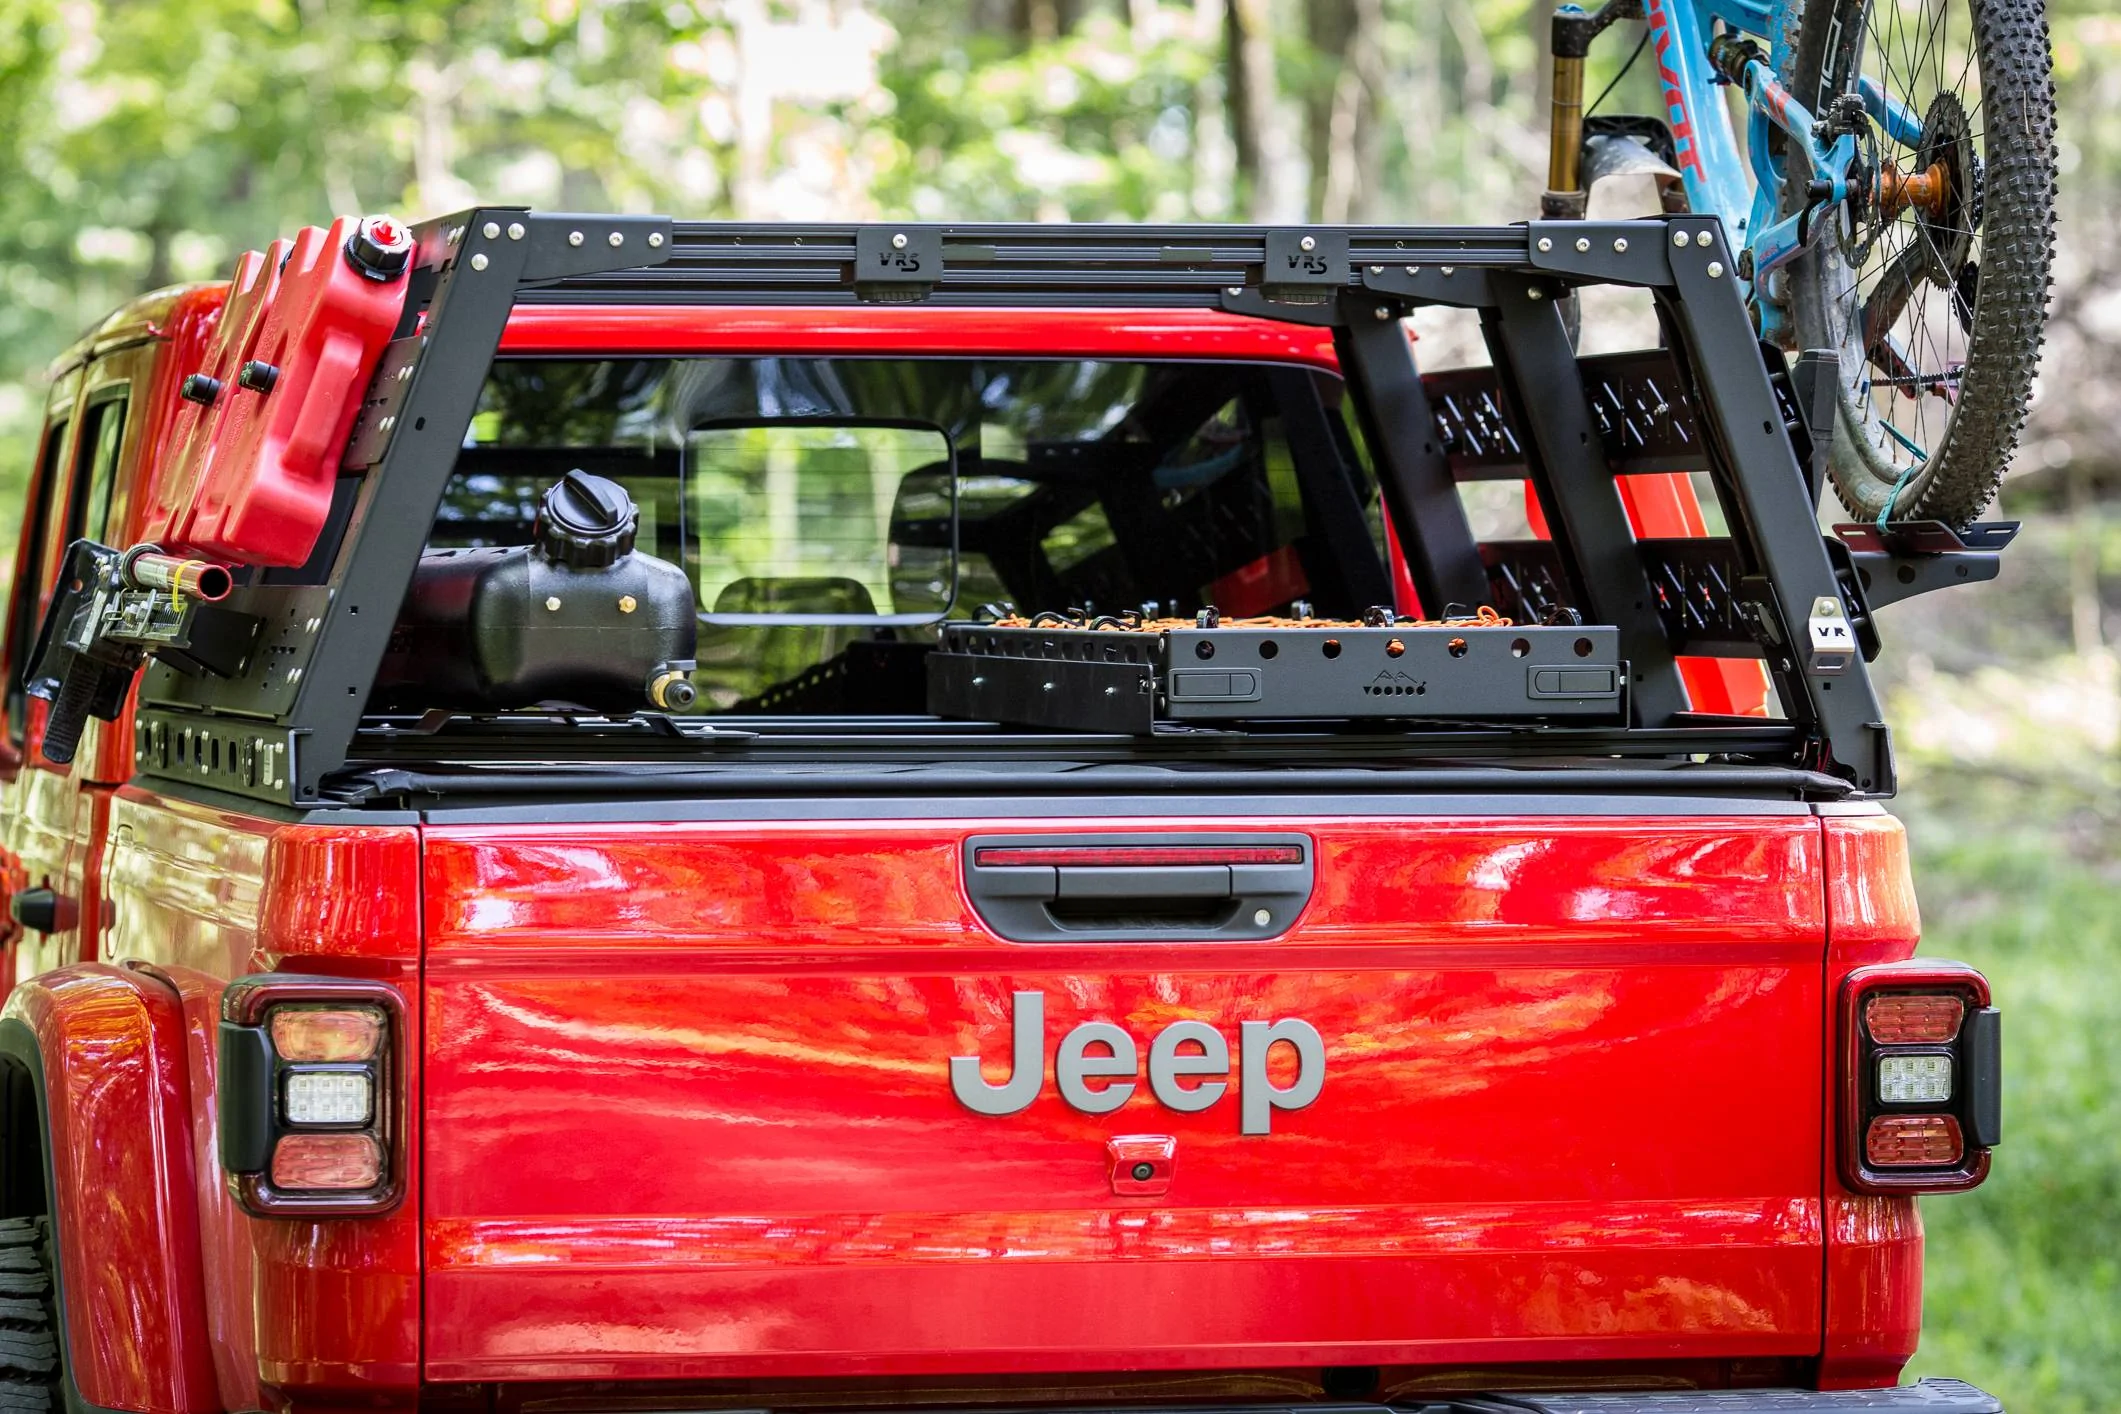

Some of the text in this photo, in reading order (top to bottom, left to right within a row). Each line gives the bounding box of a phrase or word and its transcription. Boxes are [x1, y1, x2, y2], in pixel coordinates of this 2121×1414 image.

[1649, 0, 1707, 183] IVOT
[878, 252, 920, 272] VRS
[1287, 255, 1328, 275] VRS
[1817, 627, 1846, 637] VR
[1363, 682, 1427, 696] VOODOO
[949, 990, 1327, 1137] Jeep
